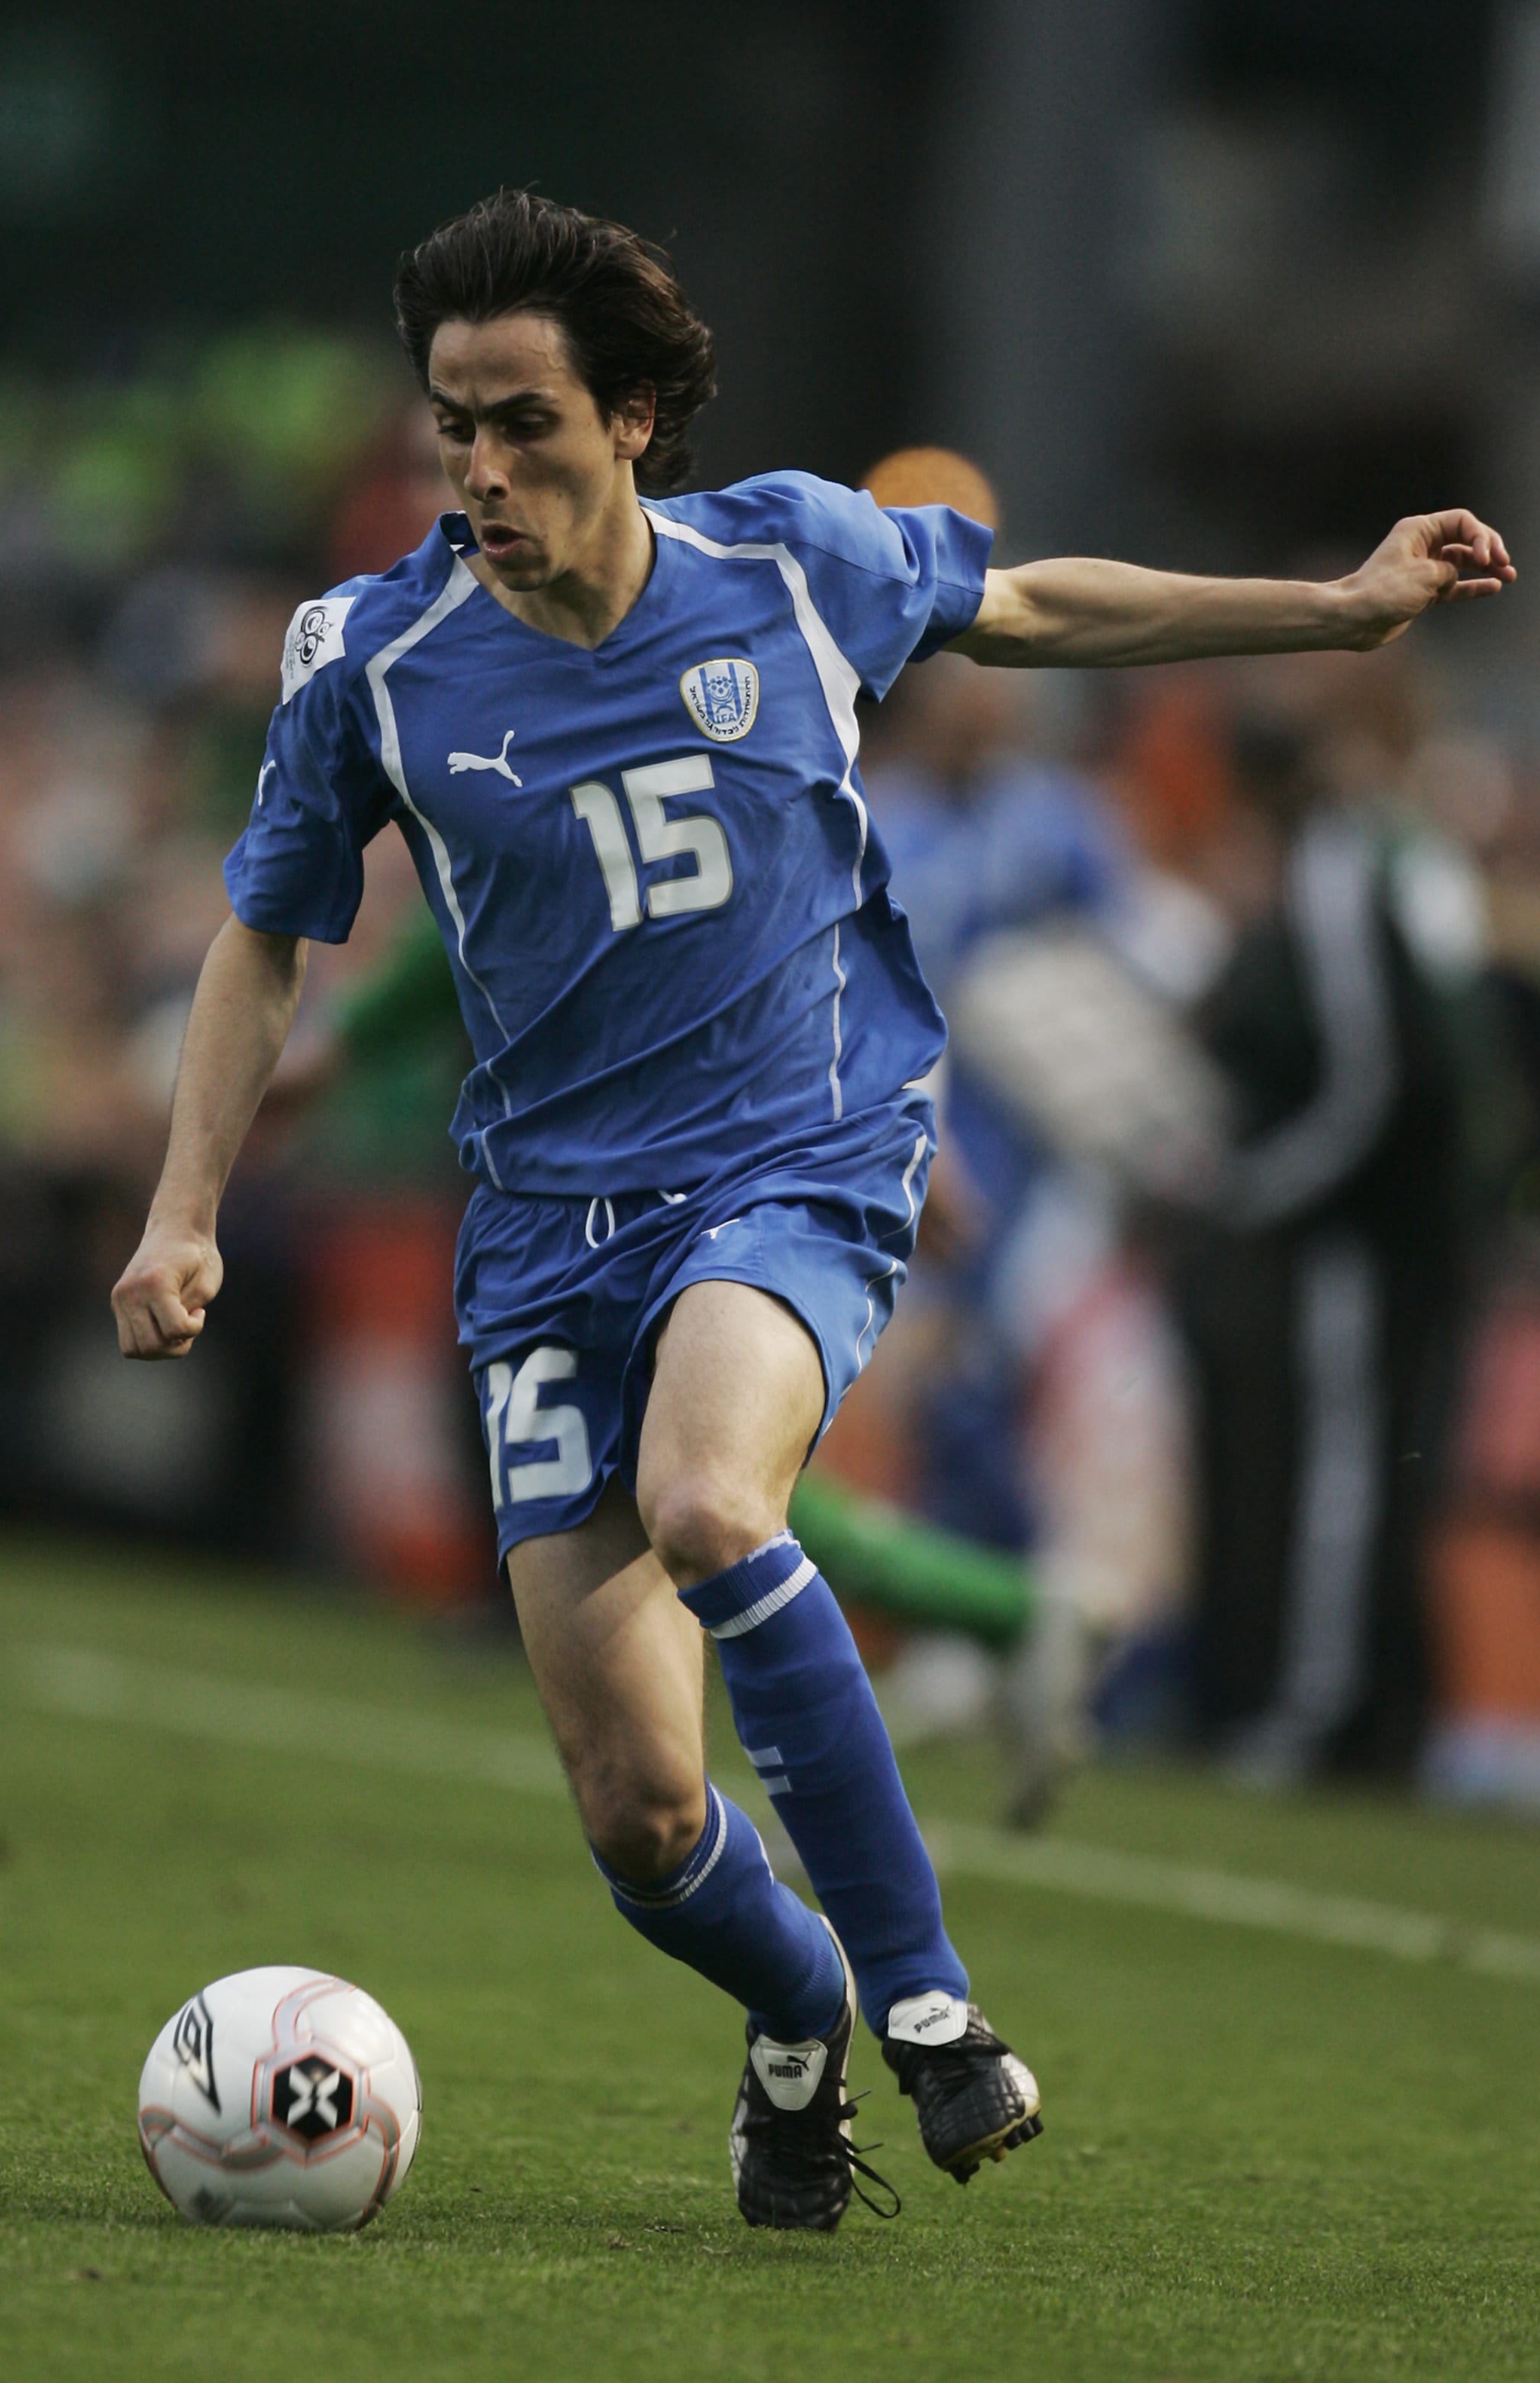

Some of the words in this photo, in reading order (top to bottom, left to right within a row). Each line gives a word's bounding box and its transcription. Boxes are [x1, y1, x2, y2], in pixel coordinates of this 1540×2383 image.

[716, 713, 736, 724] IFA
[569, 753, 733, 932] 15
[486, 1346, 592, 1509] 15
[768, 2063, 802, 2078] PUMA
